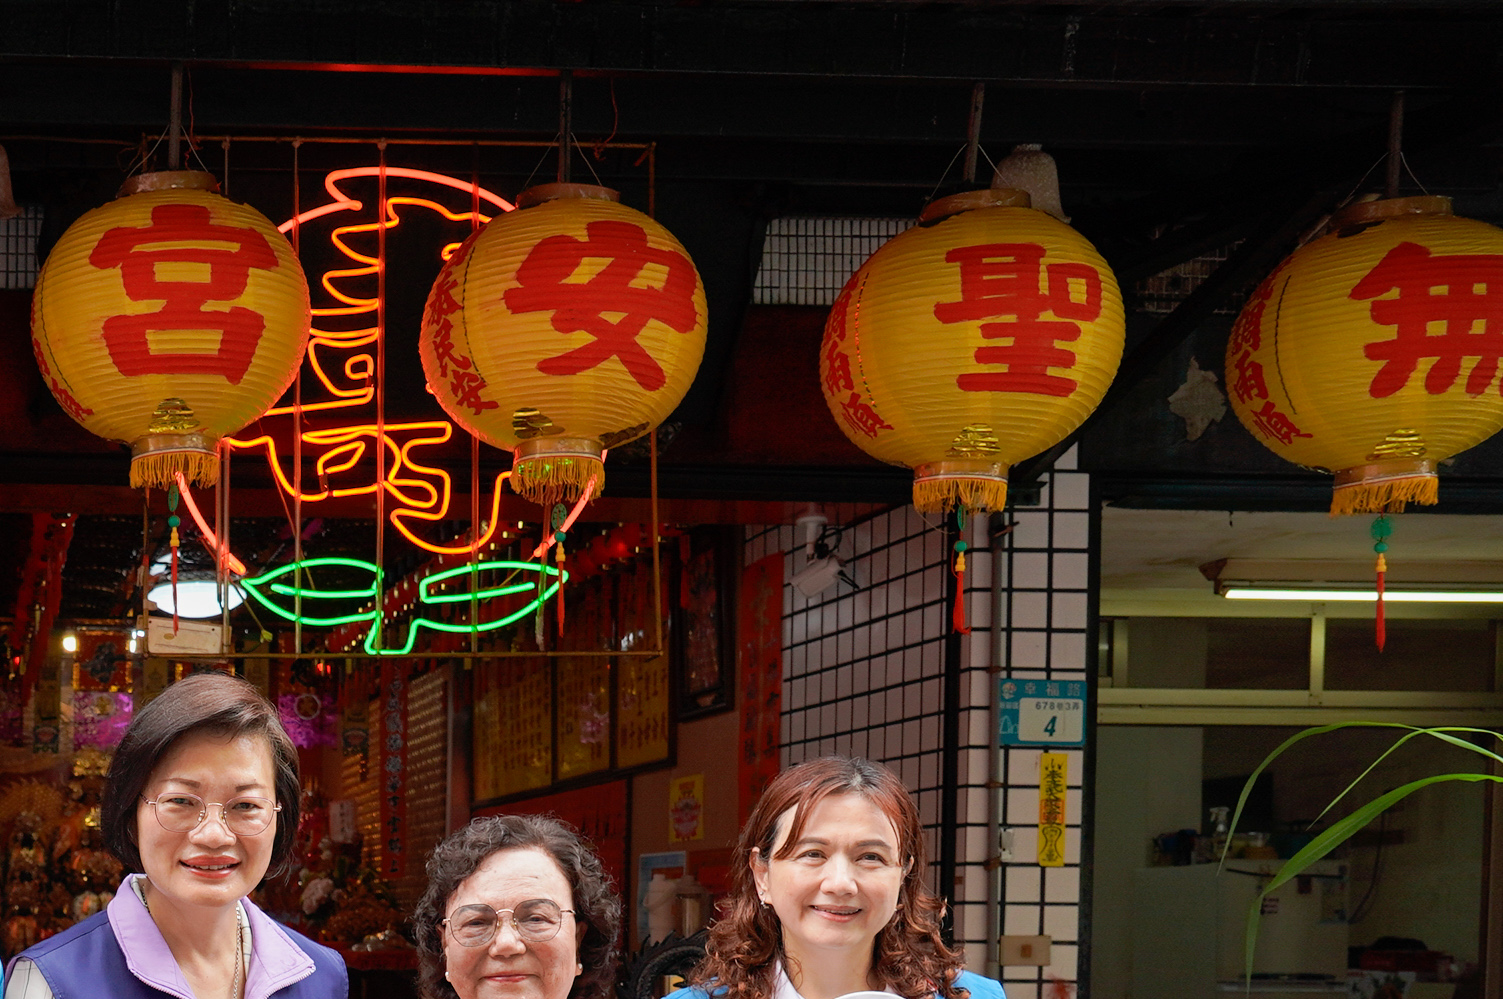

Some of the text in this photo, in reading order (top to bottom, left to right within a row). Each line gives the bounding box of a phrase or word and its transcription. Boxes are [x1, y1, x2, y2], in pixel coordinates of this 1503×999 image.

[90, 204, 279, 385] 宮
[503, 220, 697, 391] 安
[933, 242, 1103, 398] 聖
[1348, 241, 1503, 398] 無
[1043, 716, 1057, 737] 4
